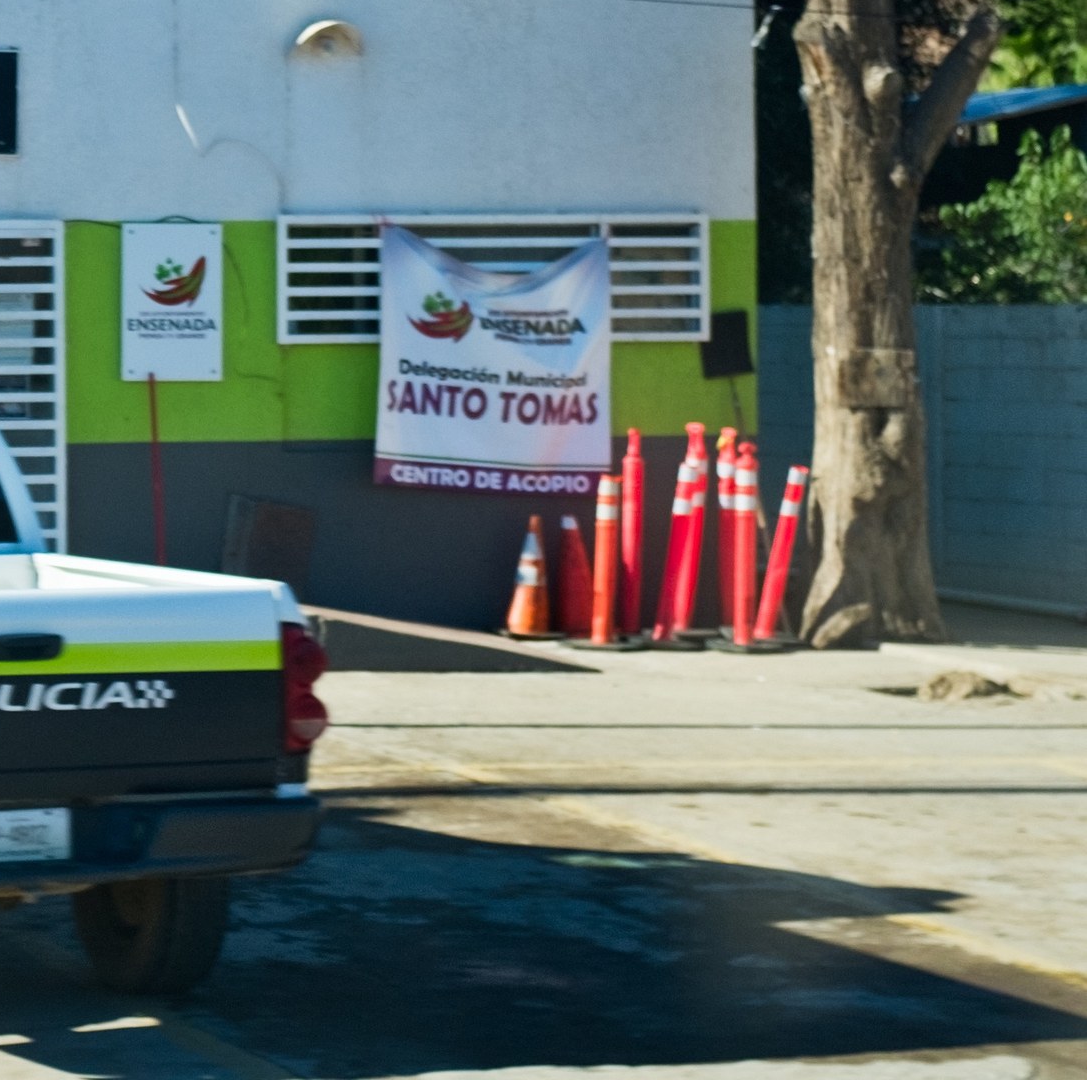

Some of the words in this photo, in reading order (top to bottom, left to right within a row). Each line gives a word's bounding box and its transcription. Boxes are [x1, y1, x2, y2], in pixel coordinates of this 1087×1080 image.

[127, 318, 217, 331] ENSENADA
[479, 317, 587, 336] ENSENADA
[507, 372, 587, 389] Municipal
[387, 381, 488, 420] SANTO
[499, 391, 598, 425] TOMAS
[390, 463, 471, 488] CENTRO
[474, 471, 503, 490] DE
[507, 473, 591, 494] ACOPIO
